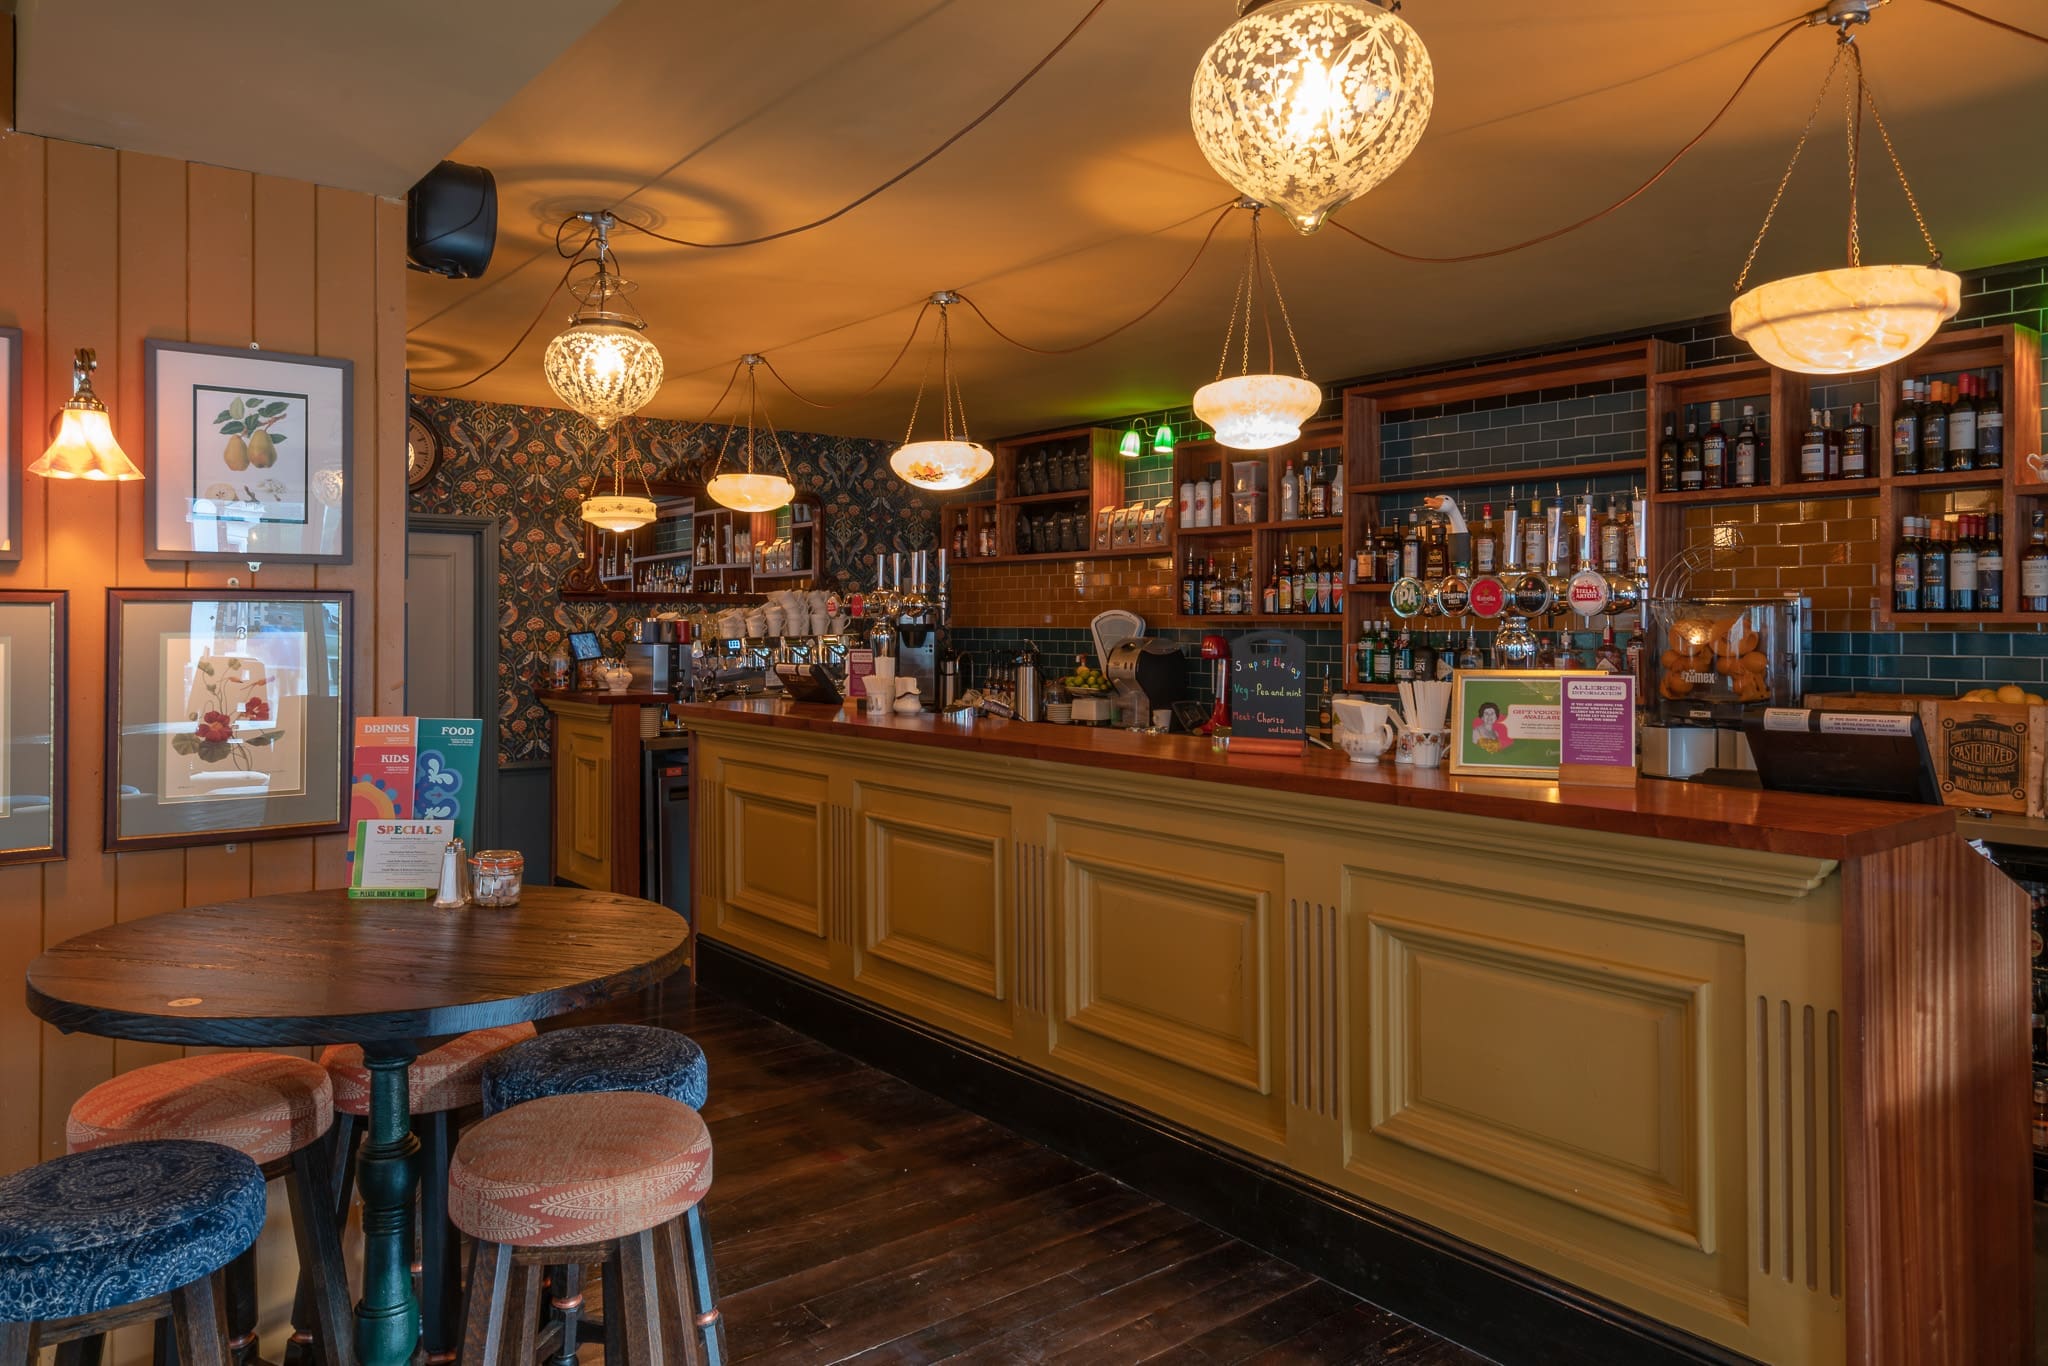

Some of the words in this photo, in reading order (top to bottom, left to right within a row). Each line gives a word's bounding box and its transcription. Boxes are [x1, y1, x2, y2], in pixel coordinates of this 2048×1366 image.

[1396, 584, 1417, 607] IPA
[1234, 683, 1249, 701] Veg
[1257, 683, 1269, 696] Pea
[1271, 686, 1284, 696] and
[1286, 688, 1302, 697] mint
[365, 724, 410, 734] DRINKS
[441, 726, 475, 736] FOOD
[381, 754, 410, 763] KIDS
[1954, 743, 2012, 764] PASTEURIZED
[377, 825, 442, 835] SPECIALS
